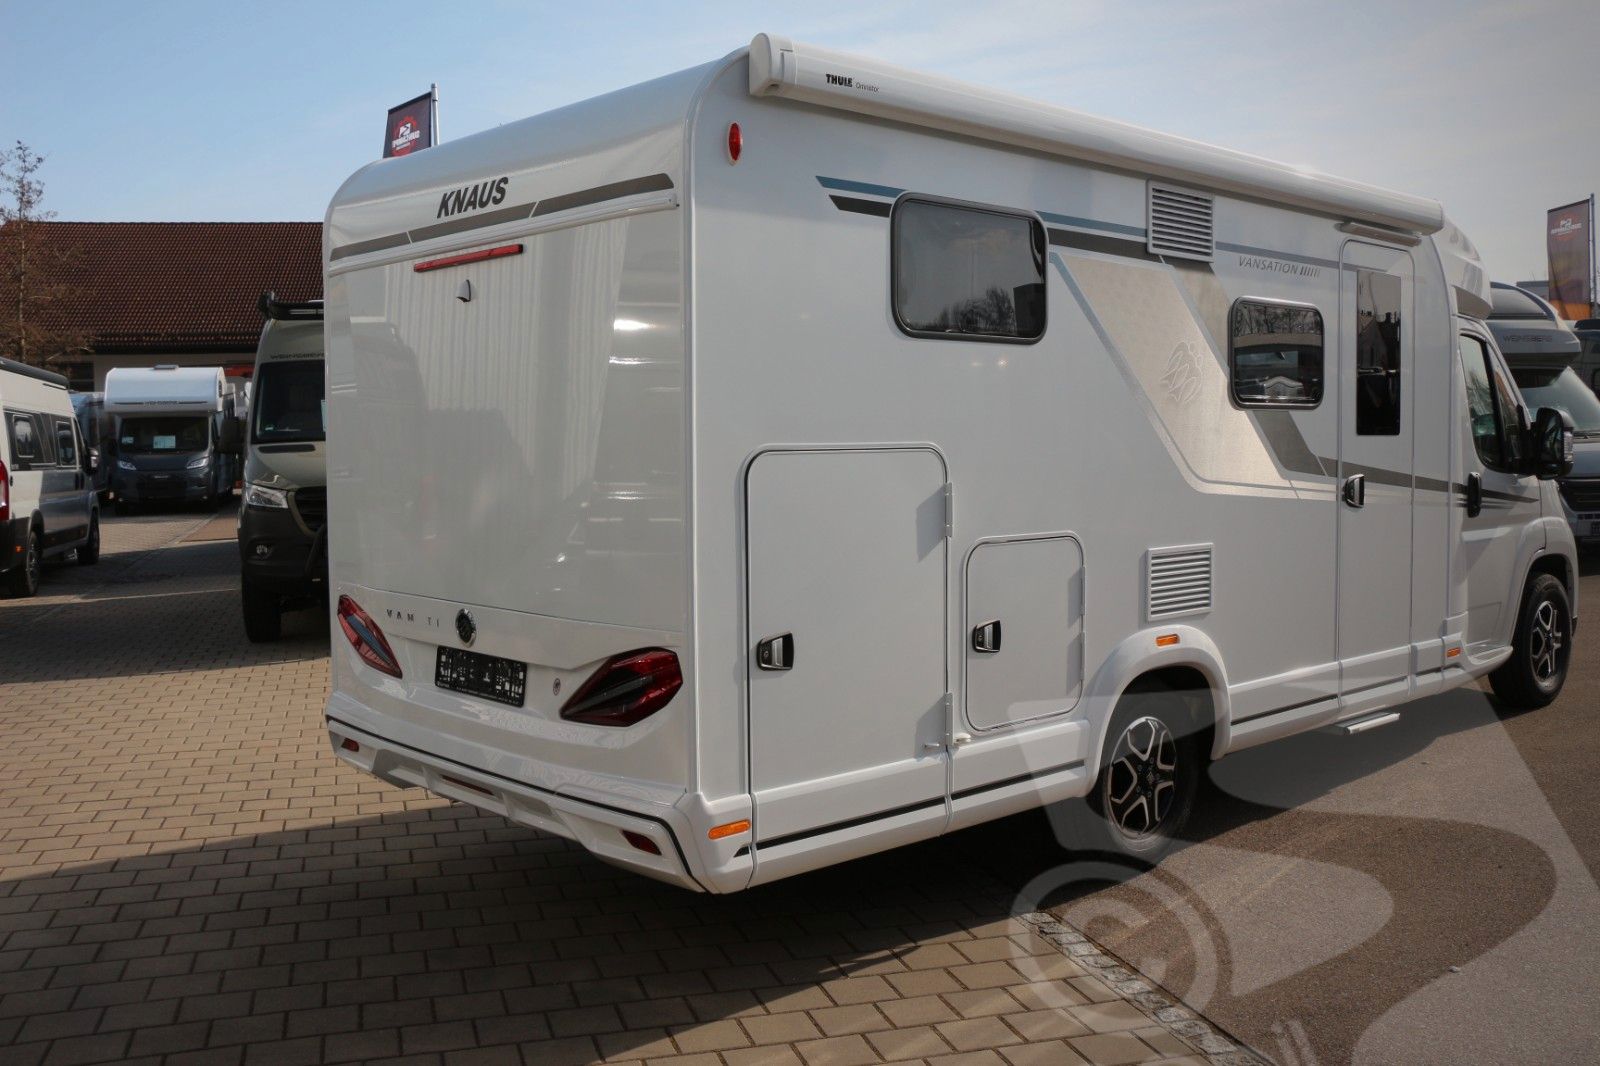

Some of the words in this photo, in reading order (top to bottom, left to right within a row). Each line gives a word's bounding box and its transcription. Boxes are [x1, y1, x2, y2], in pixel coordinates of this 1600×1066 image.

[826, 74, 853, 88] THULE
[436, 176, 509, 219] KNAUS
[1239, 256, 1299, 275] VANSATION
